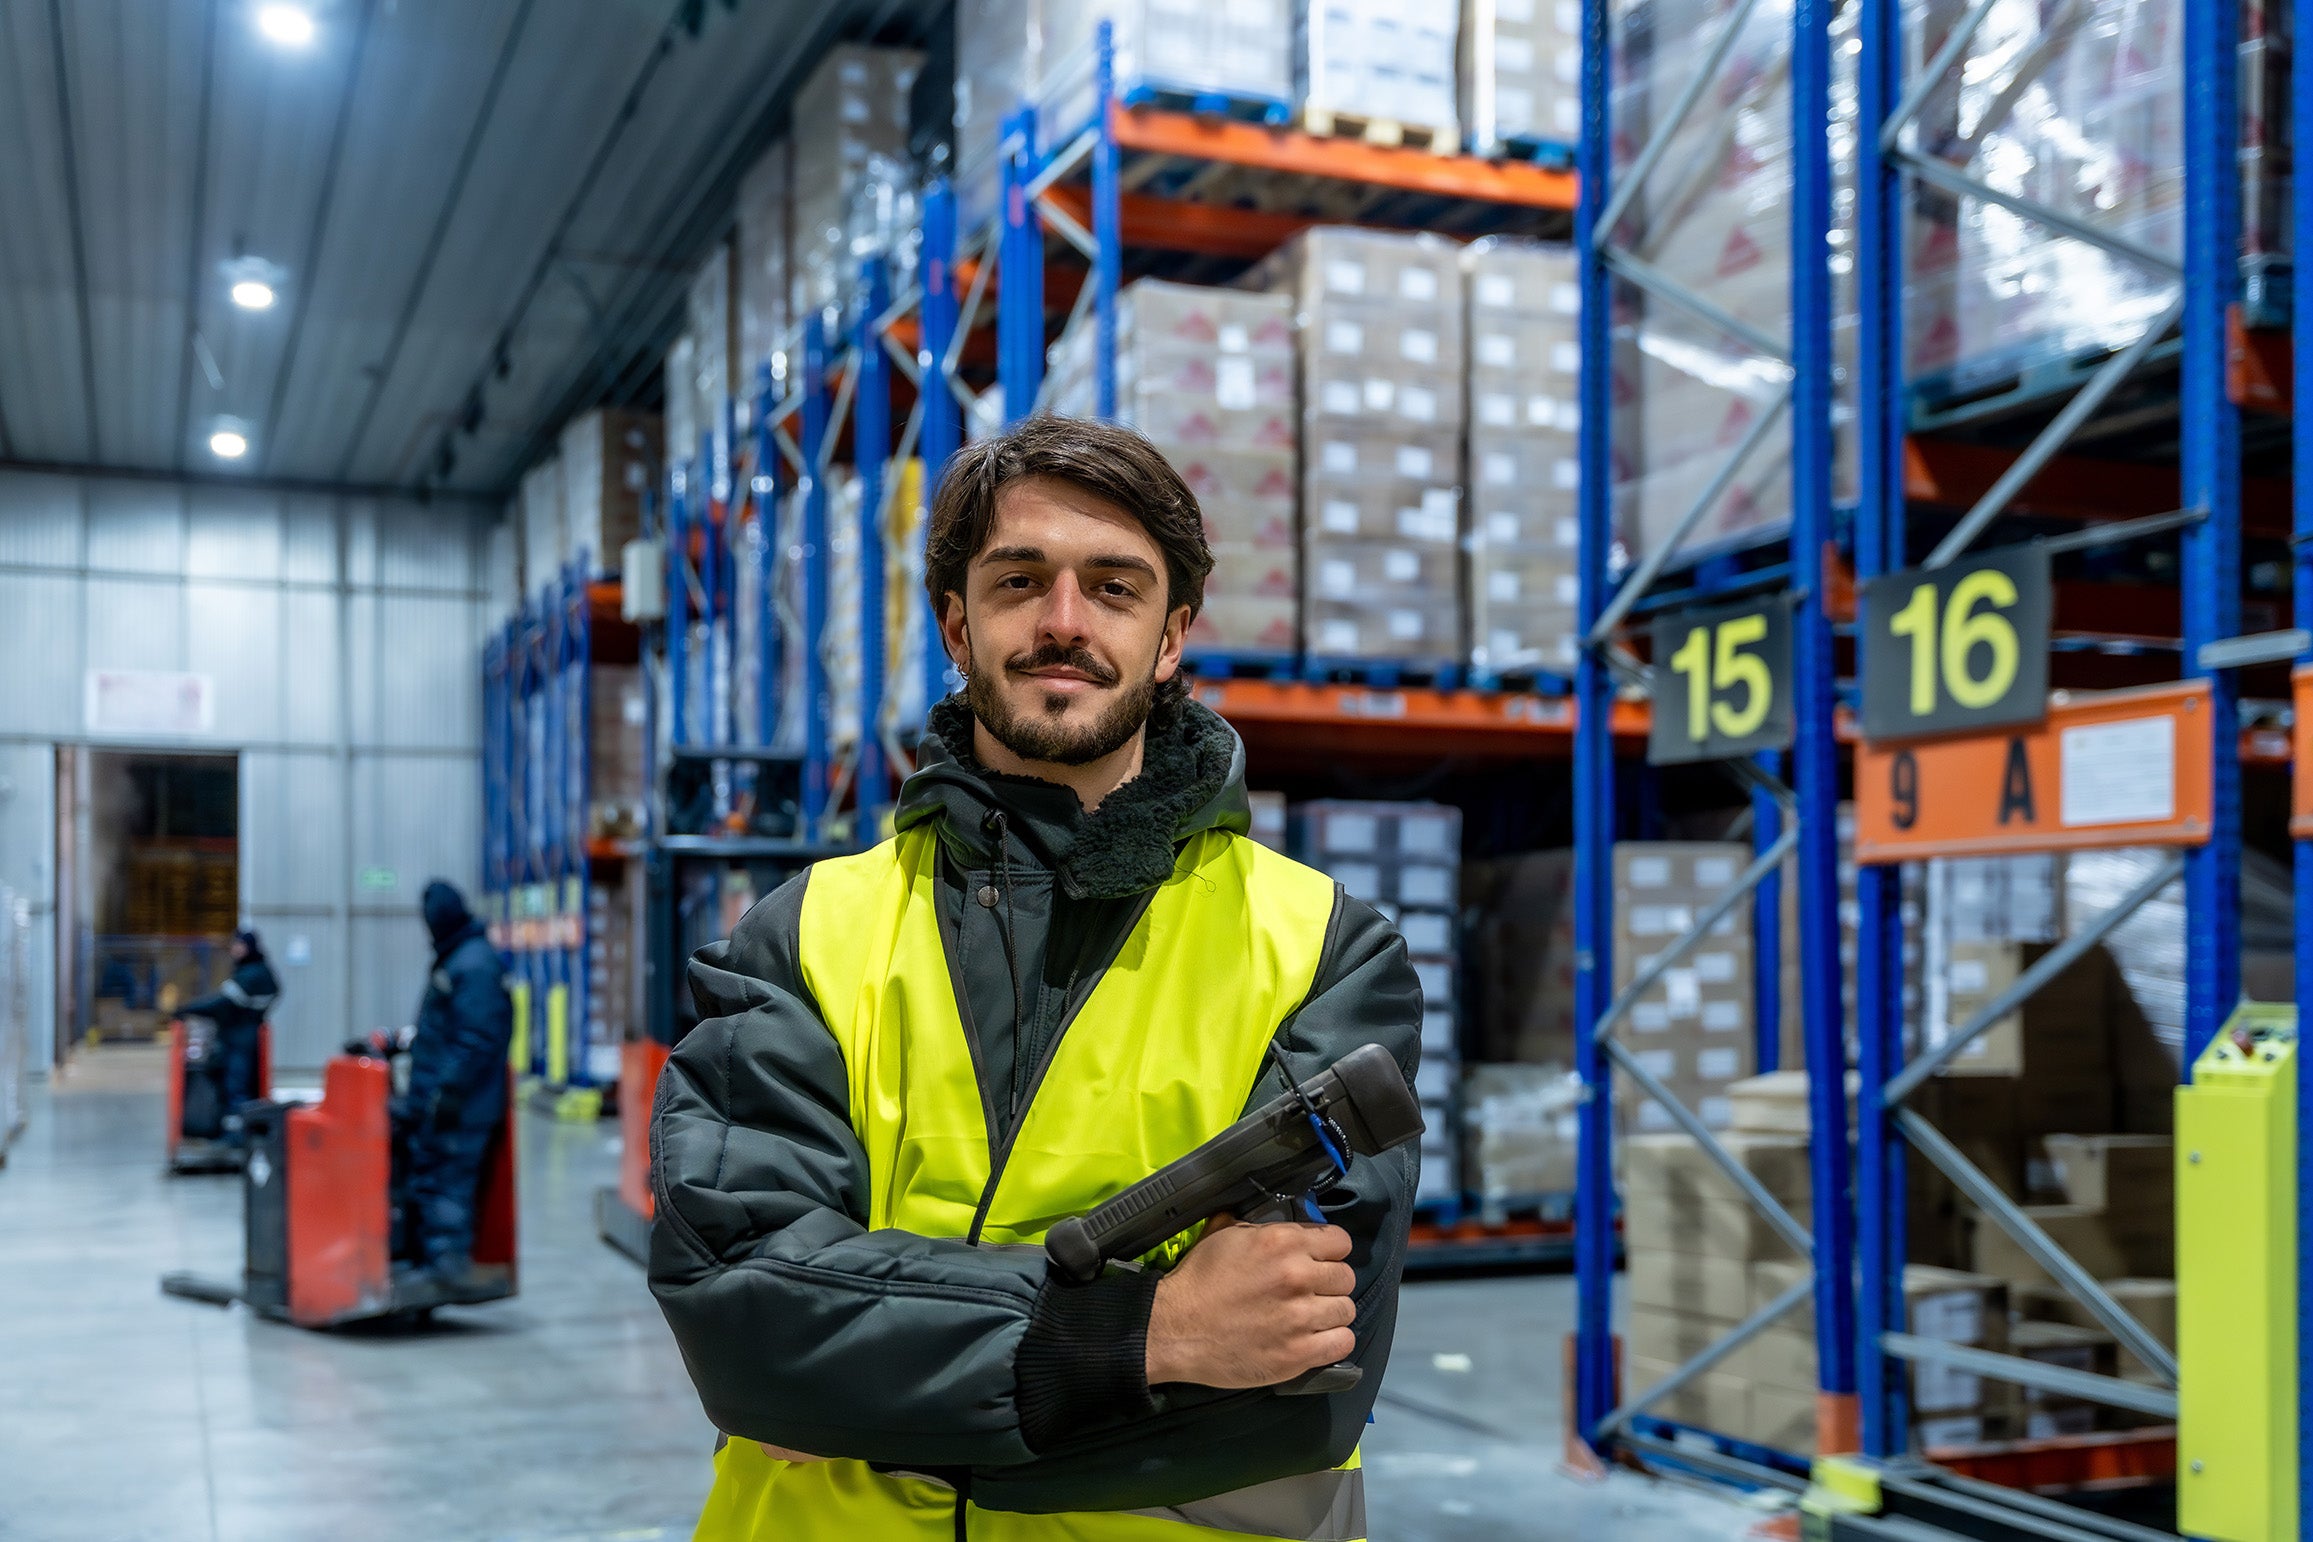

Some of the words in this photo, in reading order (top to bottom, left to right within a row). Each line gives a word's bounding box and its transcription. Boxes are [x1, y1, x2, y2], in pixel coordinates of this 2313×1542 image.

[1670, 613, 1773, 743] 15
[1890, 569, 2020, 717] 16
[1890, 750, 1919, 831] 9
[1998, 735, 2036, 826] A
